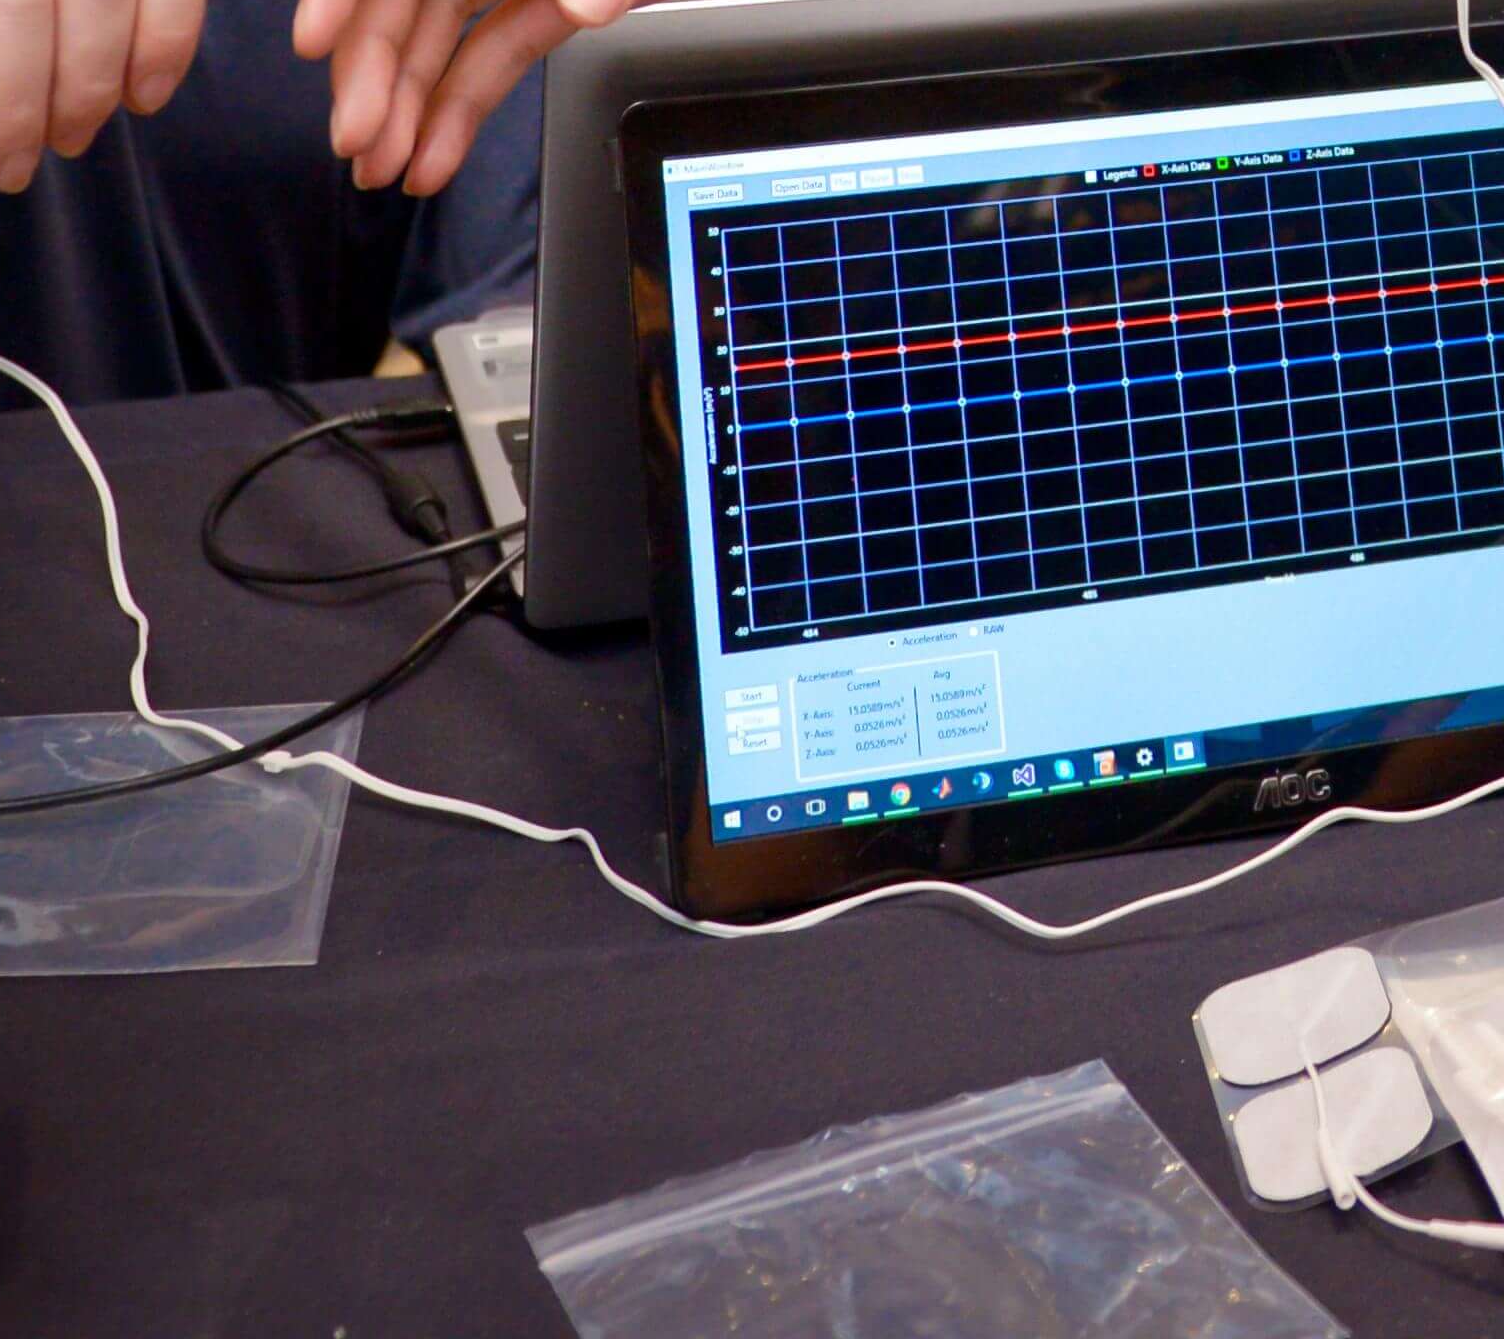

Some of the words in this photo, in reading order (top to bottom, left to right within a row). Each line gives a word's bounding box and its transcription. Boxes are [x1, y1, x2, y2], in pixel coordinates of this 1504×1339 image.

[1306, 147, 1333, 160] Z-Axis
[1334, 145, 1355, 158] Data
[1234, 155, 1262, 168] Y-Axis
[1263, 153, 1284, 165] Data
[1161, 162, 1189, 175] X-Axis
[1190, 160, 1212, 173] Data
[693, 188, 715, 200] Save
[716, 187, 738, 199] Data
[775, 182, 800, 196] Open
[802, 178, 823, 191] Data
[708, 226, 720, 237] 50
[710, 266, 723, 276] 40
[720, 385, 731, 395] 10
[727, 424, 734, 434] 0
[983, 624, 1005, 636] RAW
[901, 631, 958, 647] Acceleration
[796, 668, 854, 684] Acceleration
[933, 669, 951, 681] Avg
[846, 679, 881, 692] Current
[740, 690, 763, 702] Start
[742, 736, 768, 749] Reset
[1253, 768, 1331, 812] AOC
